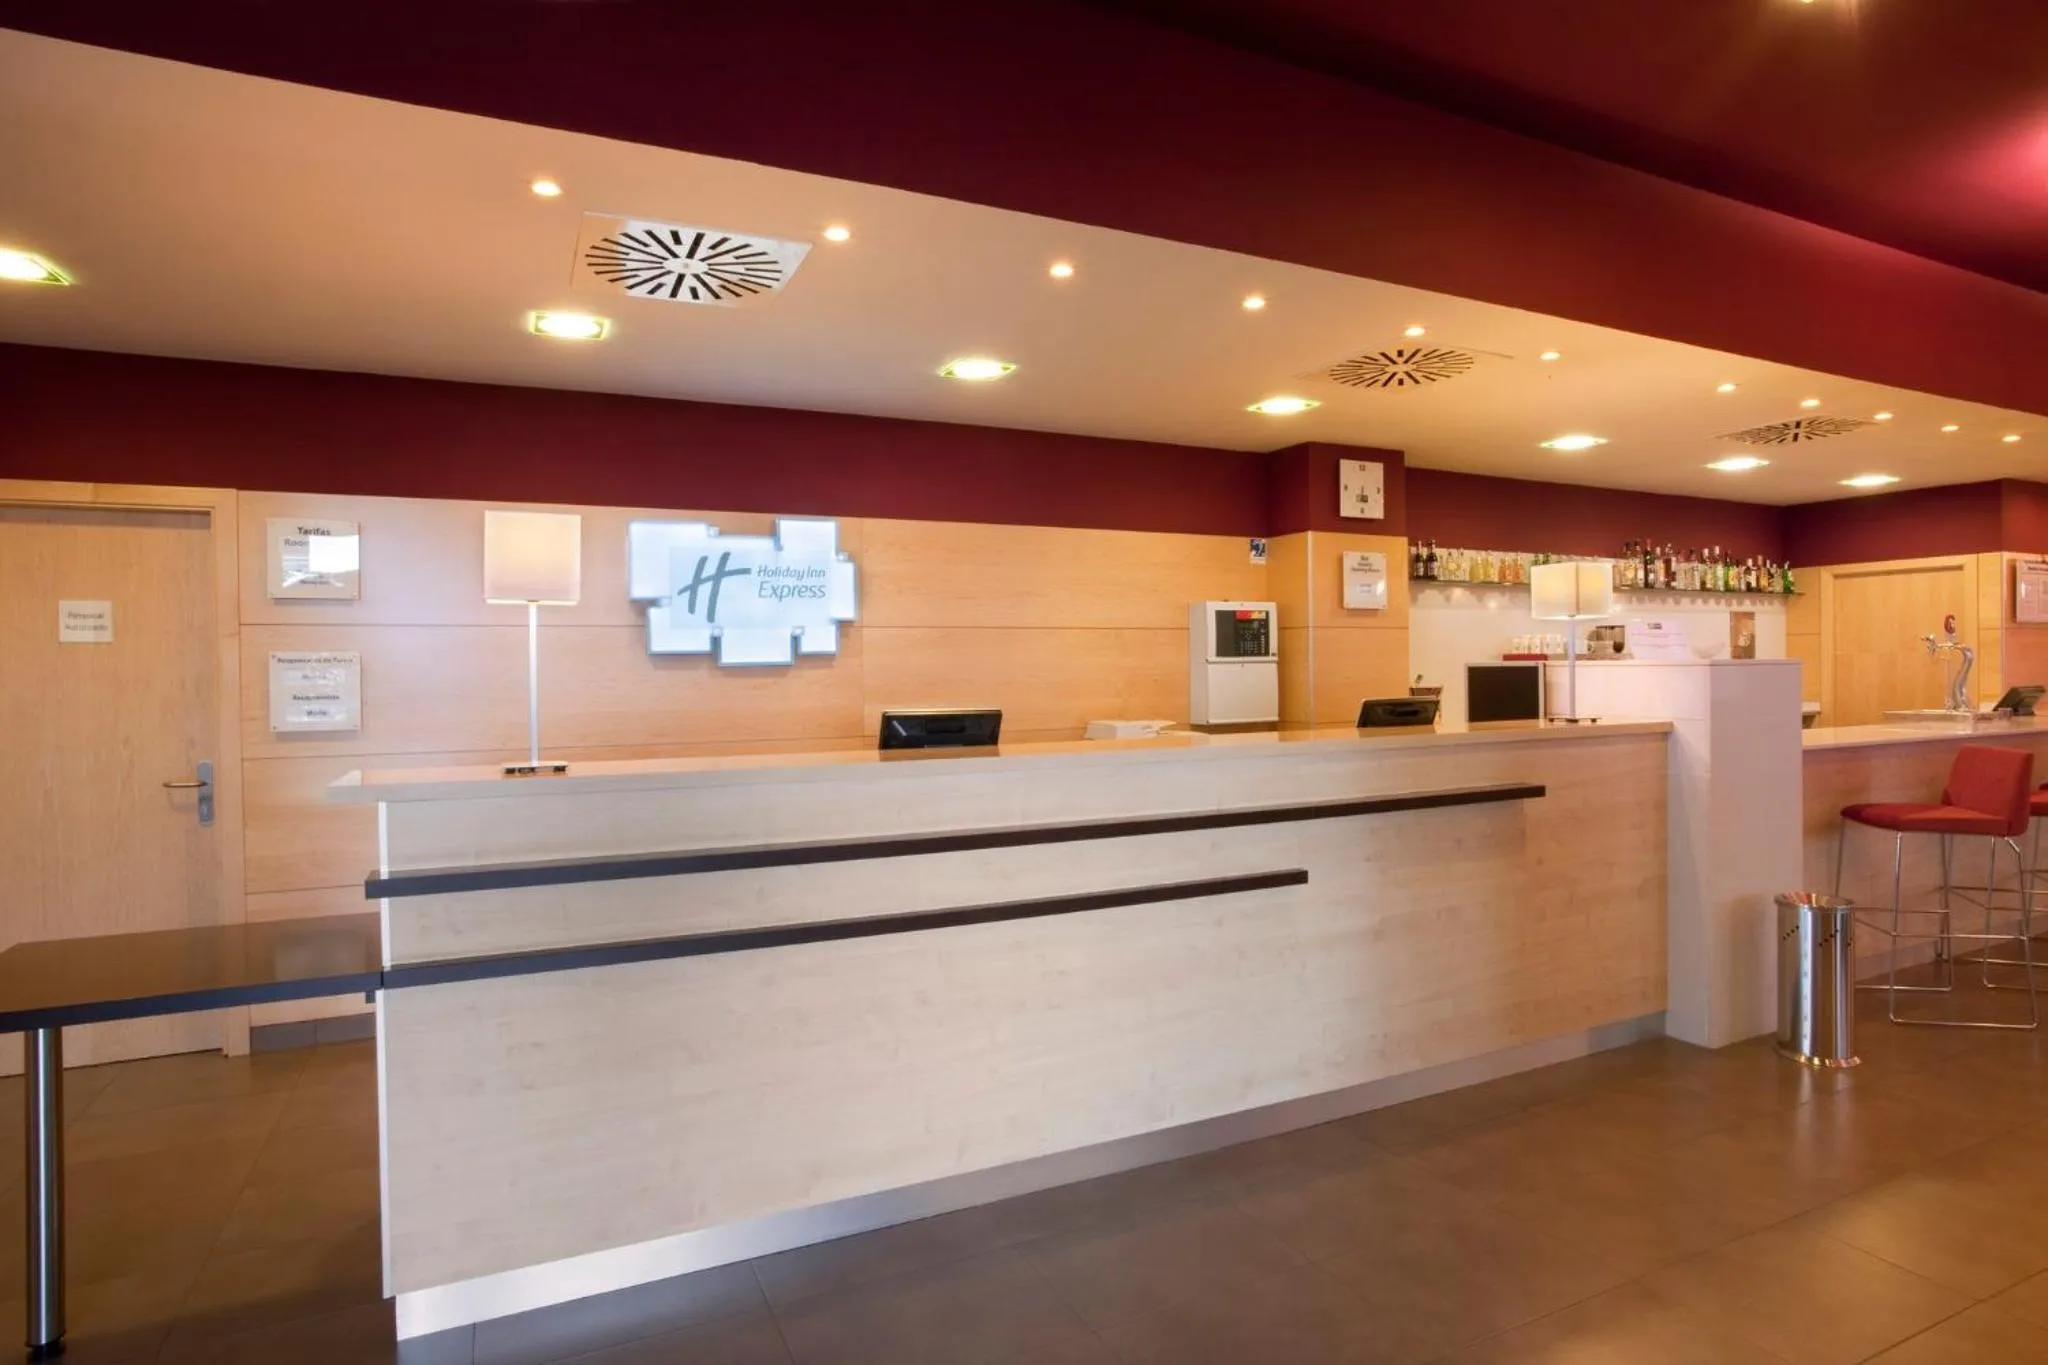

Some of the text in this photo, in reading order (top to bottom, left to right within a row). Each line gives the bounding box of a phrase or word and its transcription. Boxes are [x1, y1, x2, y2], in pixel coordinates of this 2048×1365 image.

[297, 527, 331, 536] Tarifas
[757, 564, 826, 580] Holiday Inn
[758, 580, 826, 601] Express
